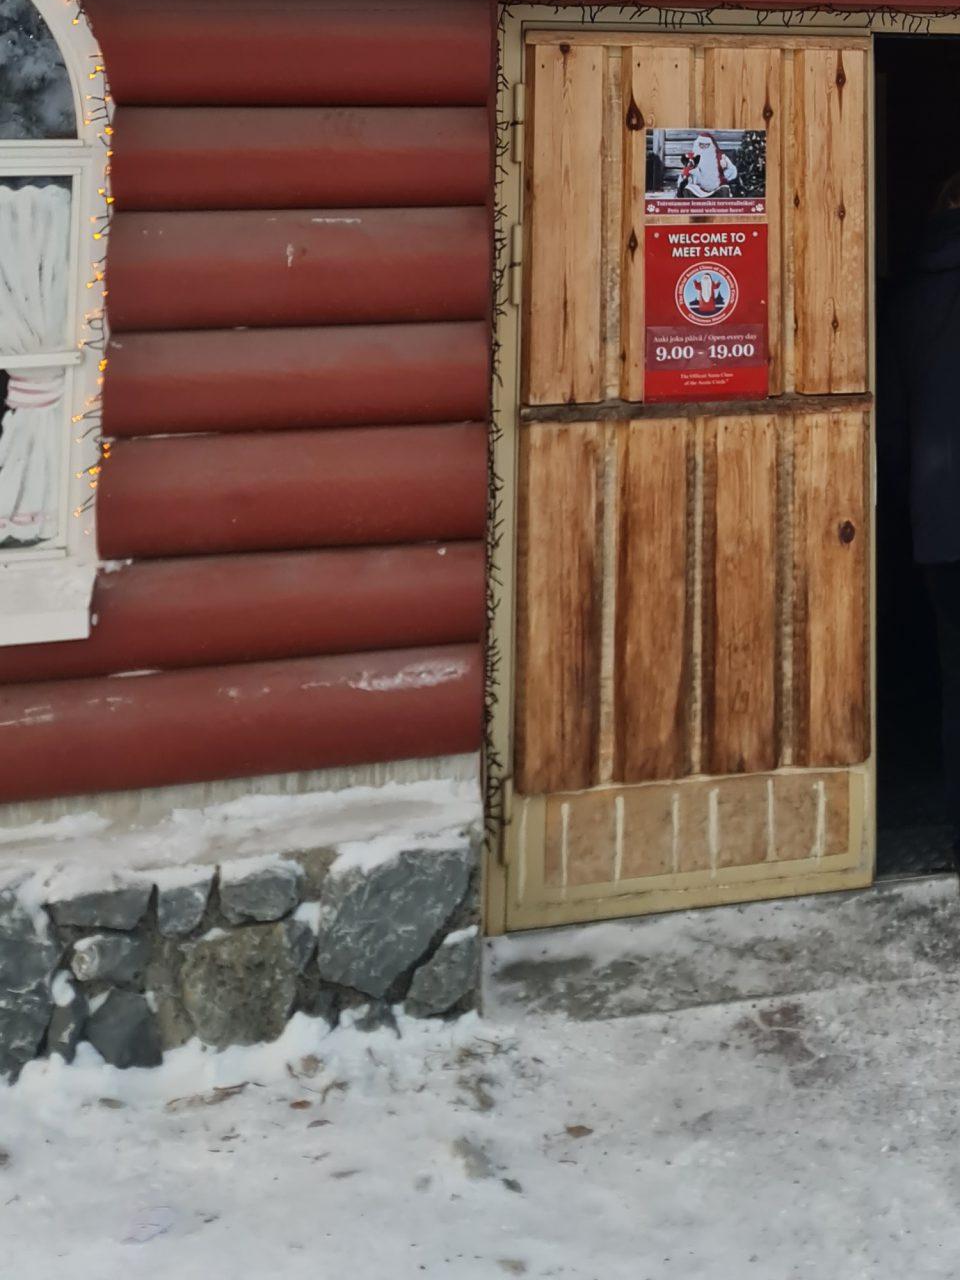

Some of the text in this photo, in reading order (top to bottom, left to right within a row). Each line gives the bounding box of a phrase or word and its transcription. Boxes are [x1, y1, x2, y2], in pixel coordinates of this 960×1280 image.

[668, 232, 746, 244] WELCOME TO
[671, 246, 742, 258] MEET SANTA
[708, 334, 726, 342] Open
[745, 333, 757, 341] day
[656, 345, 694, 361] 9.00
[708, 343, 755, 359] 19.00
